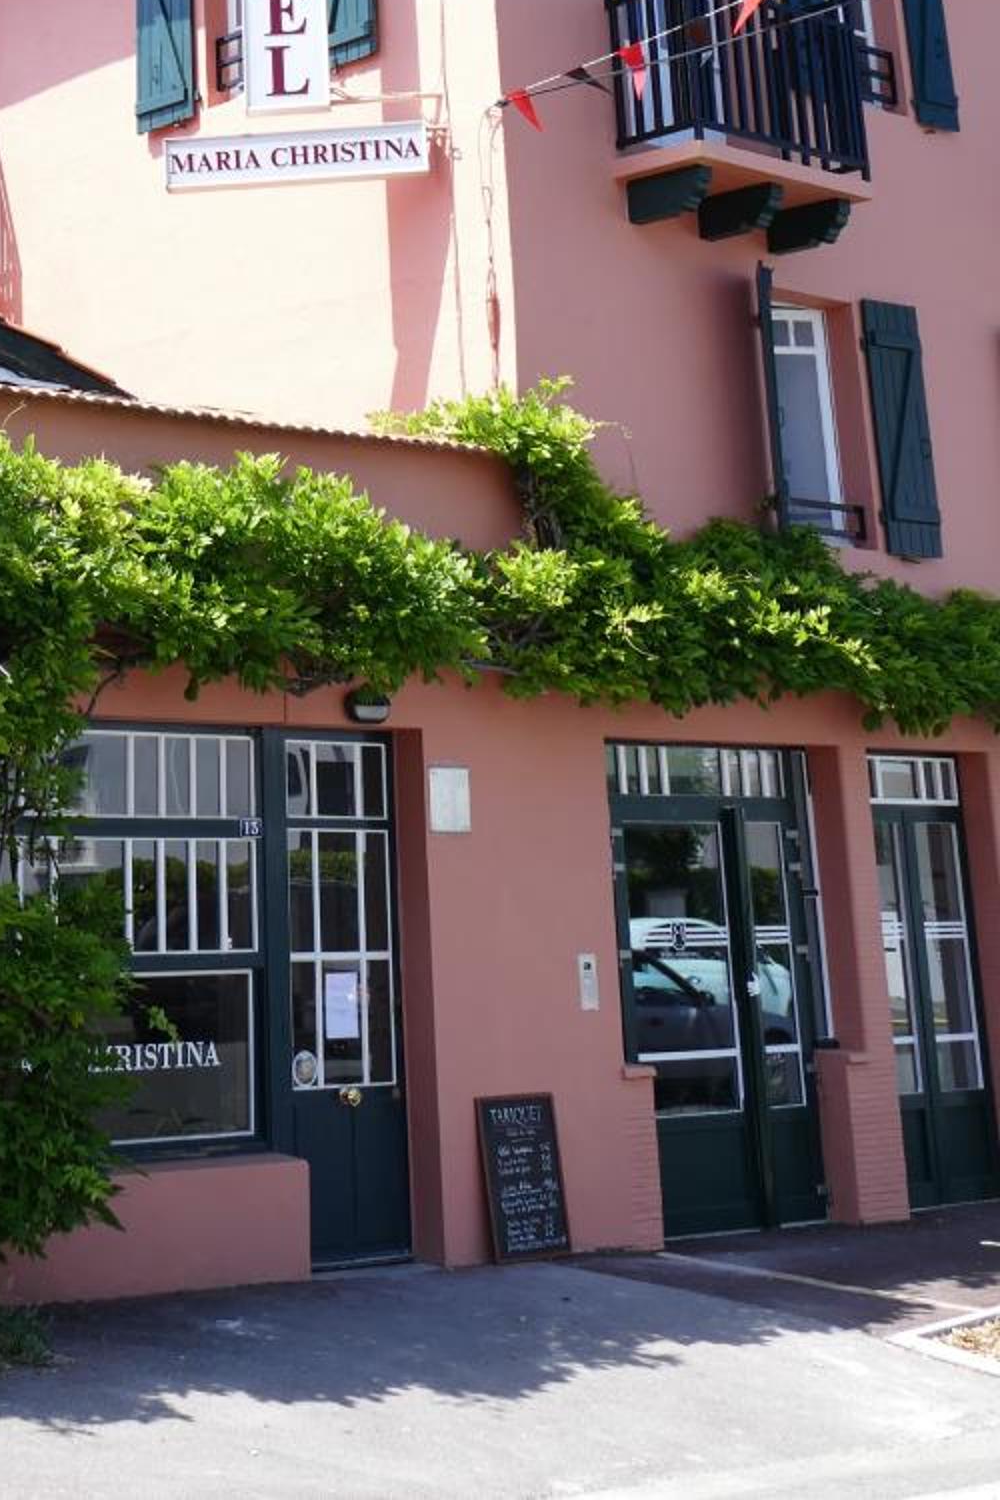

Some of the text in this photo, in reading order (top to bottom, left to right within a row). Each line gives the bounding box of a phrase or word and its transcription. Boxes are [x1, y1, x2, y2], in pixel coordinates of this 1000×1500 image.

[169, 137, 421, 175] MARIA CHRISTINA
[87, 1039, 220, 1073] RISTINA
